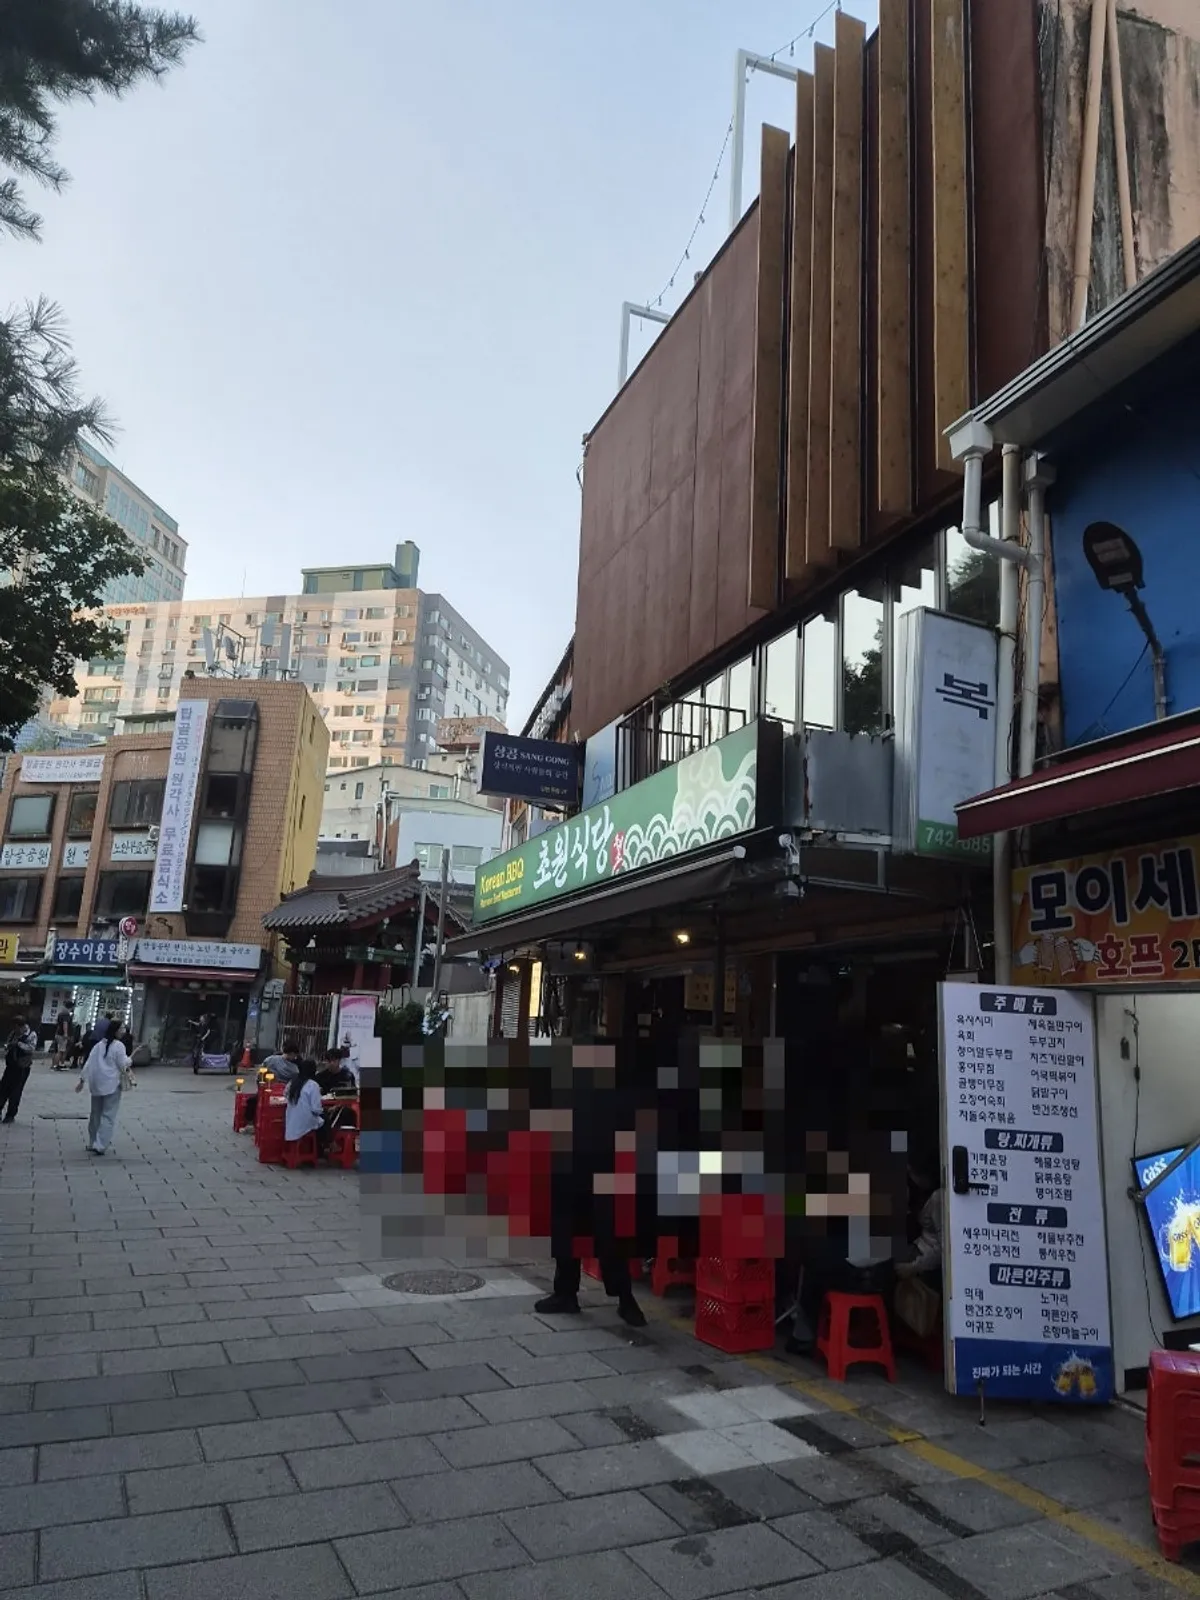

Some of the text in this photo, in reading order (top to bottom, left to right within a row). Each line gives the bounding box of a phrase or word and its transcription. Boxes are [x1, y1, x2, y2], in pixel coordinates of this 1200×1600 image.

[173, 707, 192, 766] 탑골공원
[545, 755, 569, 765] GONG
[166, 773, 184, 817] 원각사
[533, 805, 615, 889] 초원식당
[154, 827, 177, 904] 무료급식소
[480, 857, 524, 895] Korean BBQ
[1029, 847, 1200, 932] 모이세
[56, 942, 118, 961] 장수이용원
[1096, 933, 1165, 978] 호프
[957, 1014, 993, 1027] 육사시미
[1028, 1018, 1083, 1033] 제육철판구이
[957, 1030, 975, 1041] 육회
[1029, 1036, 1066, 1048] 두부김치
[1030, 1052, 1084, 1067] 치즈계란말이
[958, 1062, 995, 1075] 홍어무침
[958, 1077, 1004, 1091] 골뱅이무침
[959, 1093, 1005, 1107] 오징어숙회
[1031, 1086, 1068, 1100] 닭발구이
[1032, 1103, 1078, 1118] 반건조생선
[969, 1152, 1007, 1166] 기매운탕
[970, 1168, 1008, 1182] 추장찌개
[1035, 1171, 1072, 1186] 닭볶음탕
[1037, 1231, 1084, 1247] 해물부추전
[964, 1243, 1020, 1258] 오징어김치전
[997, 1266, 1065, 1287] 마른안주류
[964, 1288, 984, 1301] 먹태
[1041, 1293, 1068, 1306] 노가리
[965, 1303, 1023, 1320] 반건조오징어
[1041, 1309, 1079, 1323] 마른안주
[1042, 1325, 1099, 1341] 은행마늘구이
[1002, 1365, 1021, 1377] 되는
[1023, 1363, 1042, 1375] 시간
